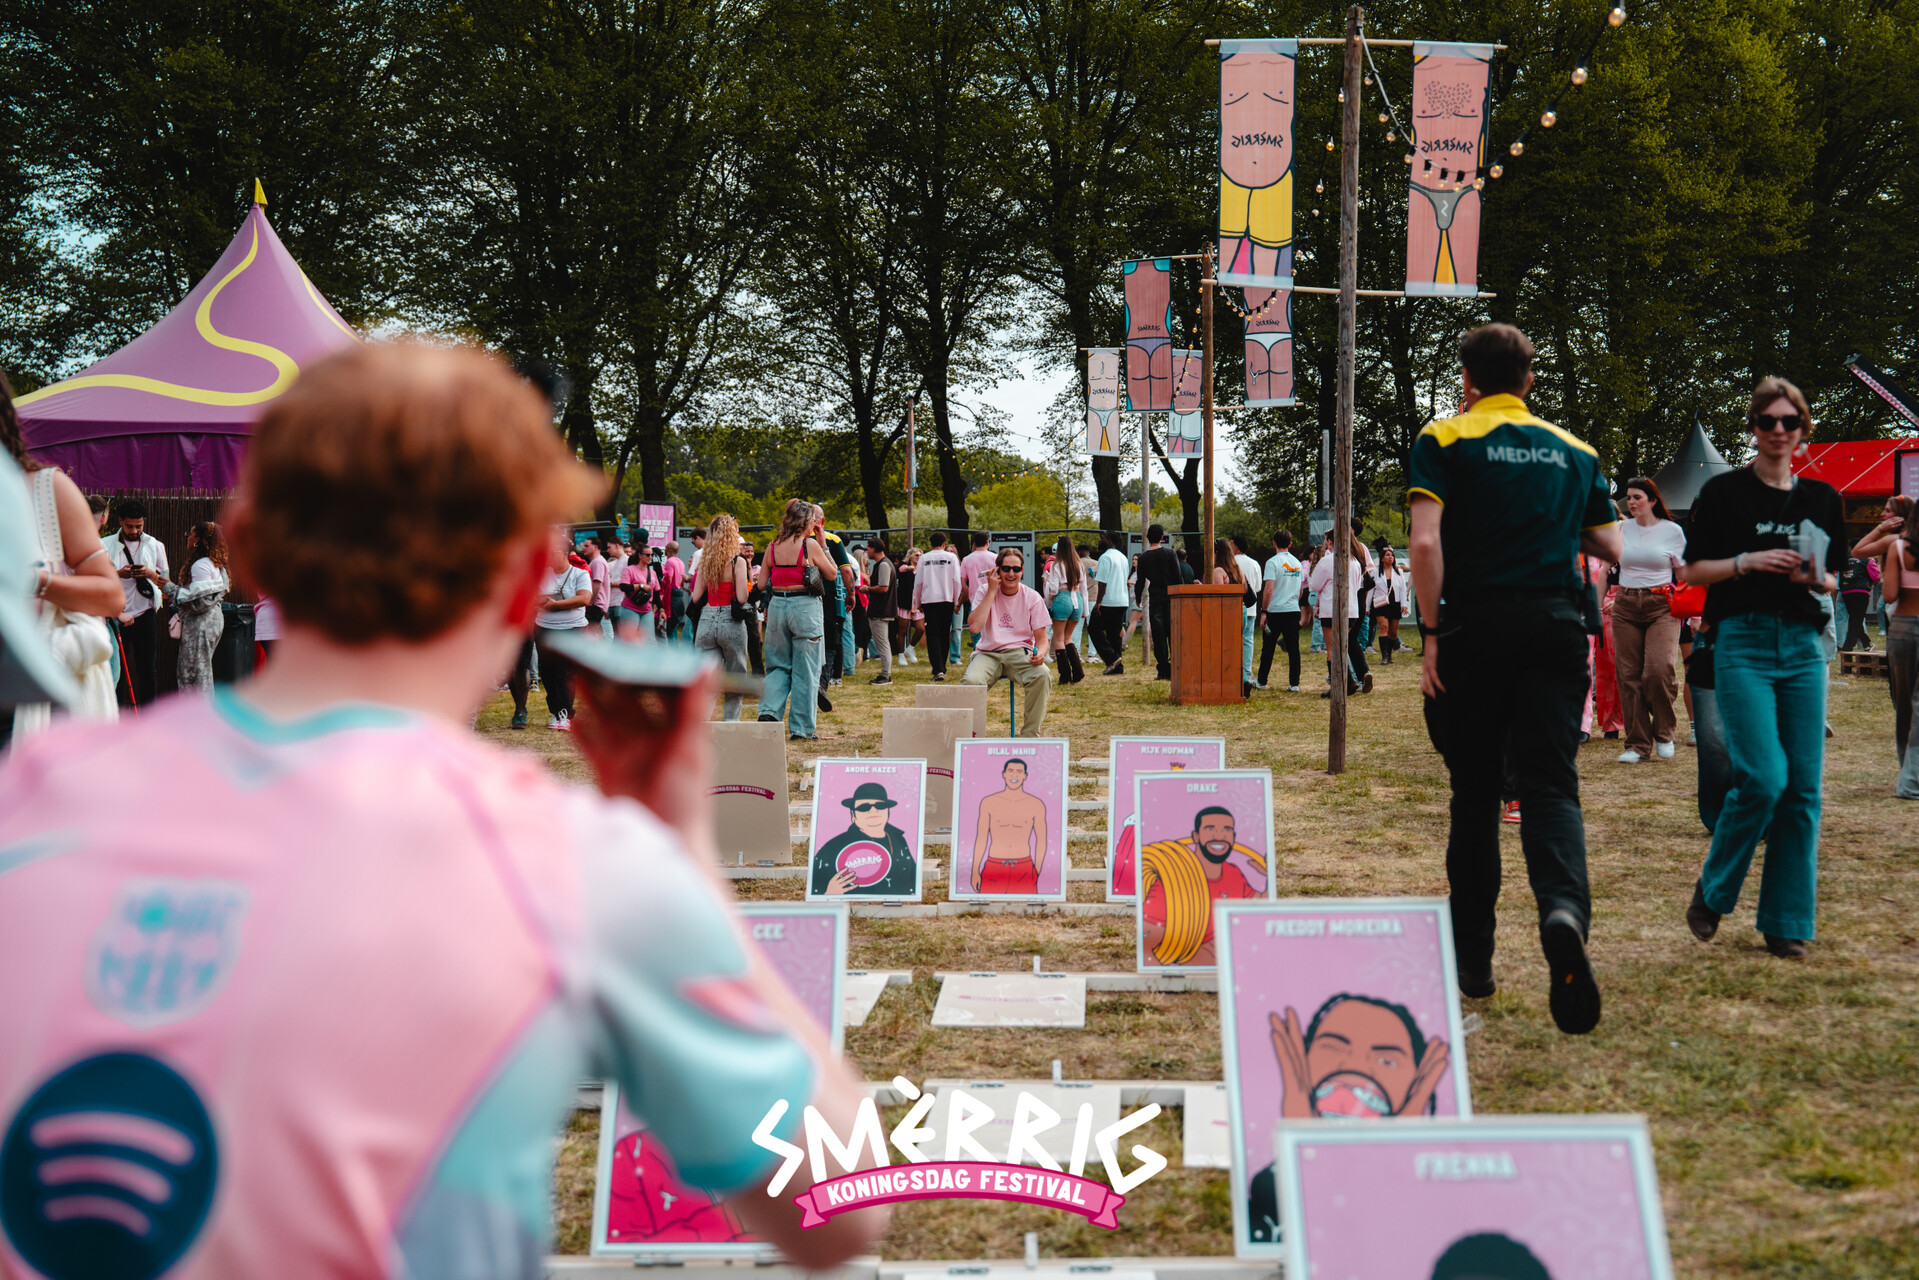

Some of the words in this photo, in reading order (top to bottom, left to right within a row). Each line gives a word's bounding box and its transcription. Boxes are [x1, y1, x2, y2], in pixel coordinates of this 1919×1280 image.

[1486, 446, 1568, 469] MEDICAL
[987, 747, 1010, 755] BILAL
[1012, 747, 1036, 755] WAHIB
[1141, 746, 1160, 754] RIJK
[845, 765, 870, 773] ANDRÉ
[741, 786, 766, 794] FESTIVAL
[1187, 783, 1217, 793] DRAKE
[753, 923, 785, 940] CEE
[1265, 918, 1325, 936] FREDDY
